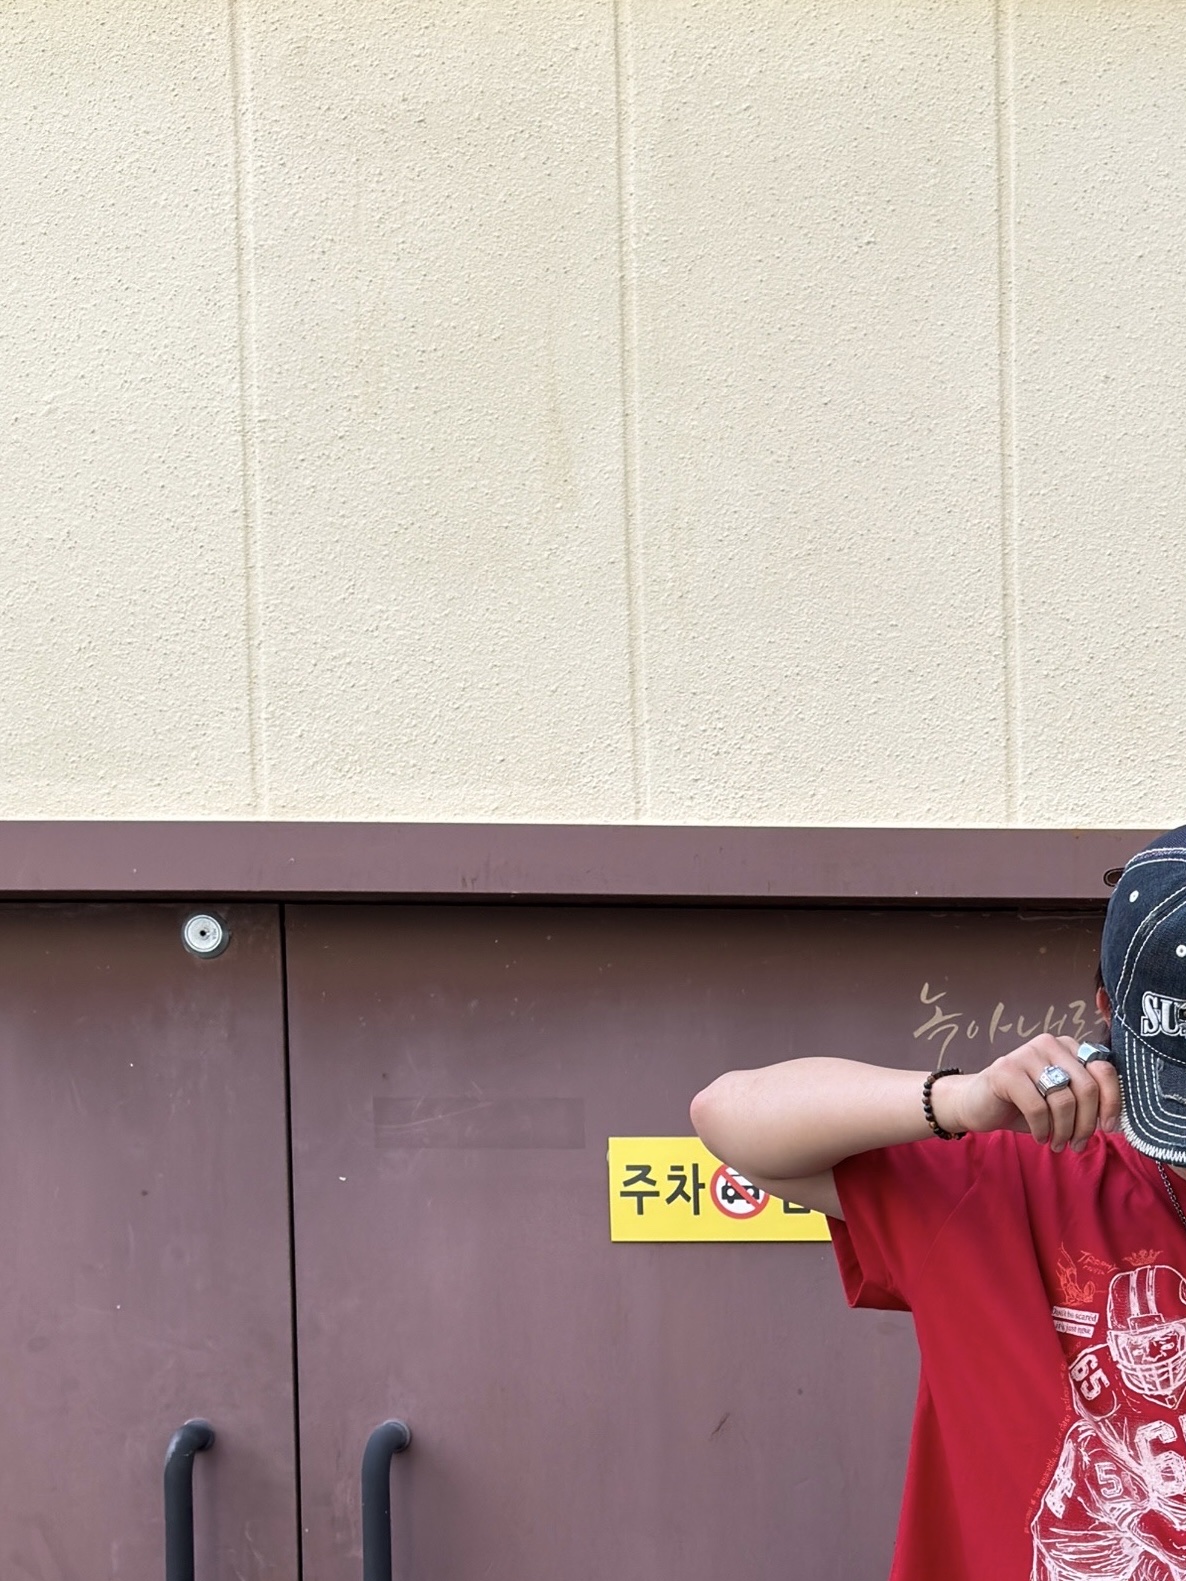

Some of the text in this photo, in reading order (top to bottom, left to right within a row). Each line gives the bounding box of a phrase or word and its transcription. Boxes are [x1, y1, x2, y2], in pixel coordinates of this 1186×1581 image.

[620, 1163, 706, 1215] 주차
[1075, 1312, 1097, 1323] scared
[1070, 1354, 1110, 1401] 65
